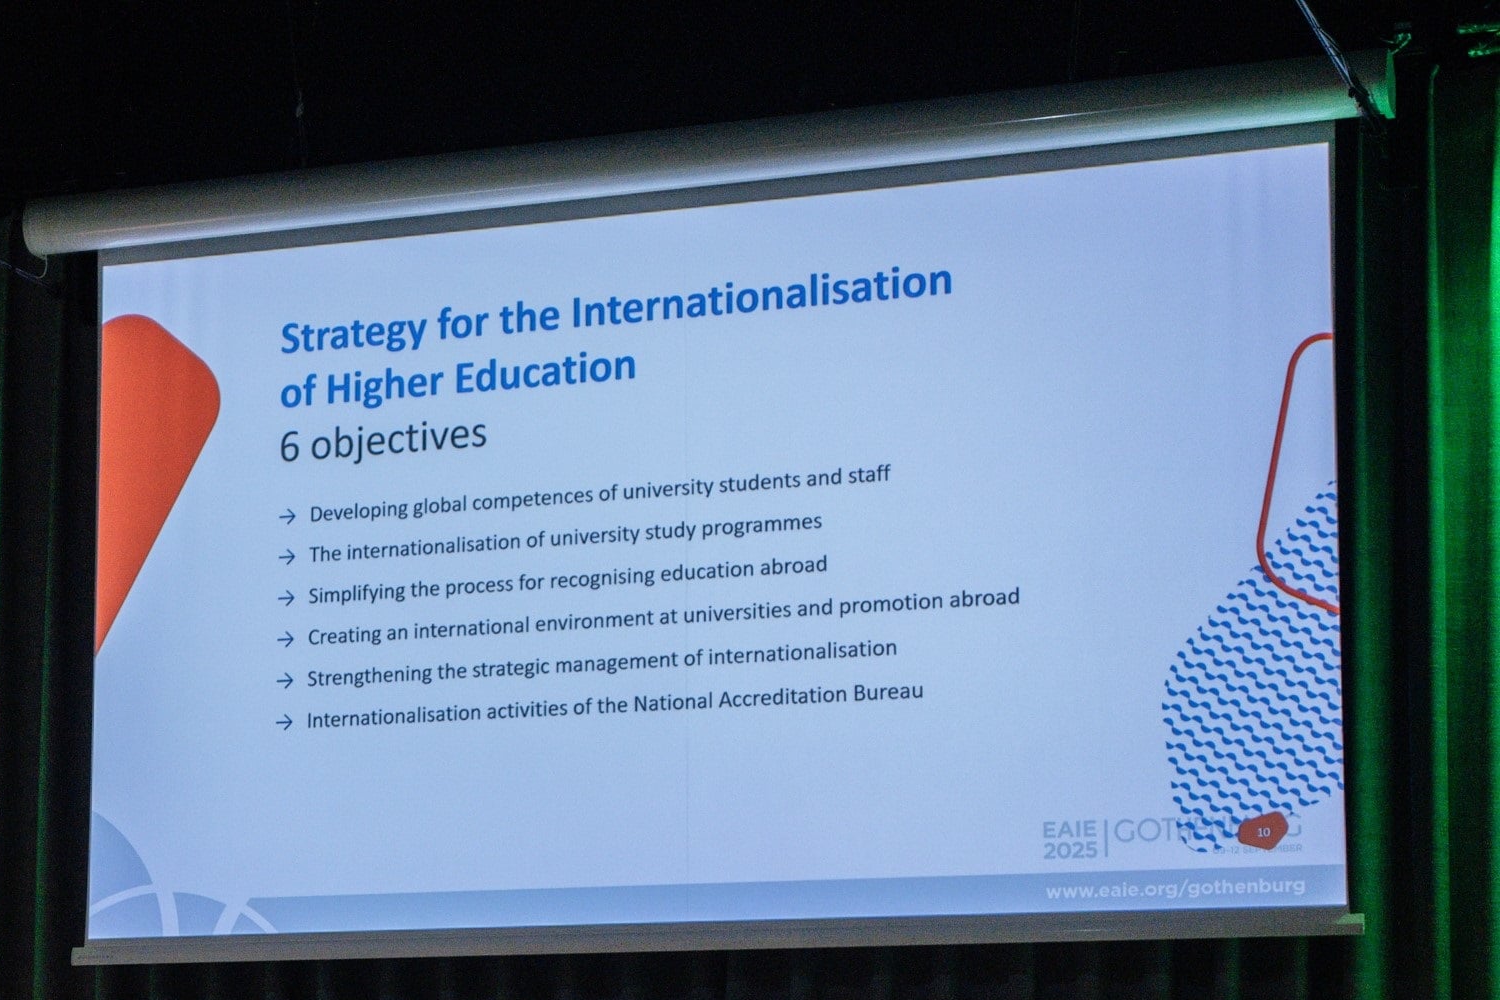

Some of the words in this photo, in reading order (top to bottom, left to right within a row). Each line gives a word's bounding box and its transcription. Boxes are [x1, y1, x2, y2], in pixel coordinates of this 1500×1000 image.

[280, 318, 428, 355] Strategy
[436, 306, 490, 341] for
[498, 300, 561, 335] the
[572, 265, 952, 329] Internationalisation
[280, 373, 318, 409] of
[327, 367, 445, 410] Higher
[455, 350, 636, 394] Education
[280, 430, 300, 463] 6
[310, 420, 488, 466] objectives
[310, 500, 409, 523] Developing
[412, 494, 467, 520] global
[471, 489, 594, 512] competences
[598, 483, 619, 502] of
[622, 478, 715, 501] university
[718, 472, 802, 494] students
[806, 467, 843, 488] and
[847, 463, 892, 485] staff
[308, 544, 342, 563] The
[346, 533, 521, 561] internationalisation
[525, 529, 546, 549] of
[550, 525, 641, 547] university
[644, 520, 697, 542] study
[701, 515, 823, 541] programmes
[308, 583, 406, 607] Simplifying
[409, 580, 441, 598] the
[445, 578, 514, 600] process
[518, 573, 546, 592] for
[550, 567, 656, 591] recognising
[660, 560, 755, 583] education
[759, 554, 828, 576] abroad
[308, 626, 382, 646] Creating
[386, 627, 409, 642] an
[413, 615, 530, 640] international
[534, 609, 655, 633] environment
[659, 608, 679, 626] at
[683, 601, 792, 624] universities
[796, 597, 833, 618] and
[839, 592, 943, 619] promotion
[949, 586, 1020, 609] abroad
[307, 664, 433, 689] Strengthening
[436, 662, 468, 681] the
[472, 657, 550, 680] strategic
[555, 651, 679, 675] management
[683, 647, 705, 667] of
[708, 639, 898, 666] internationalisation
[307, 704, 481, 729] Internationalisation
[486, 699, 569, 720] activities
[572, 696, 594, 716] of
[596, 696, 629, 715] the
[633, 690, 713, 713] National
[718, 685, 848, 709] Accreditation
[853, 684, 924, 702] Bureau
[1042, 820, 1098, 839] EAIE
[1042, 840, 1099, 860] 2025
[1257, 827, 1271, 838] 10
[1045, 878, 1307, 900] www.eaie.org/gothenburg
